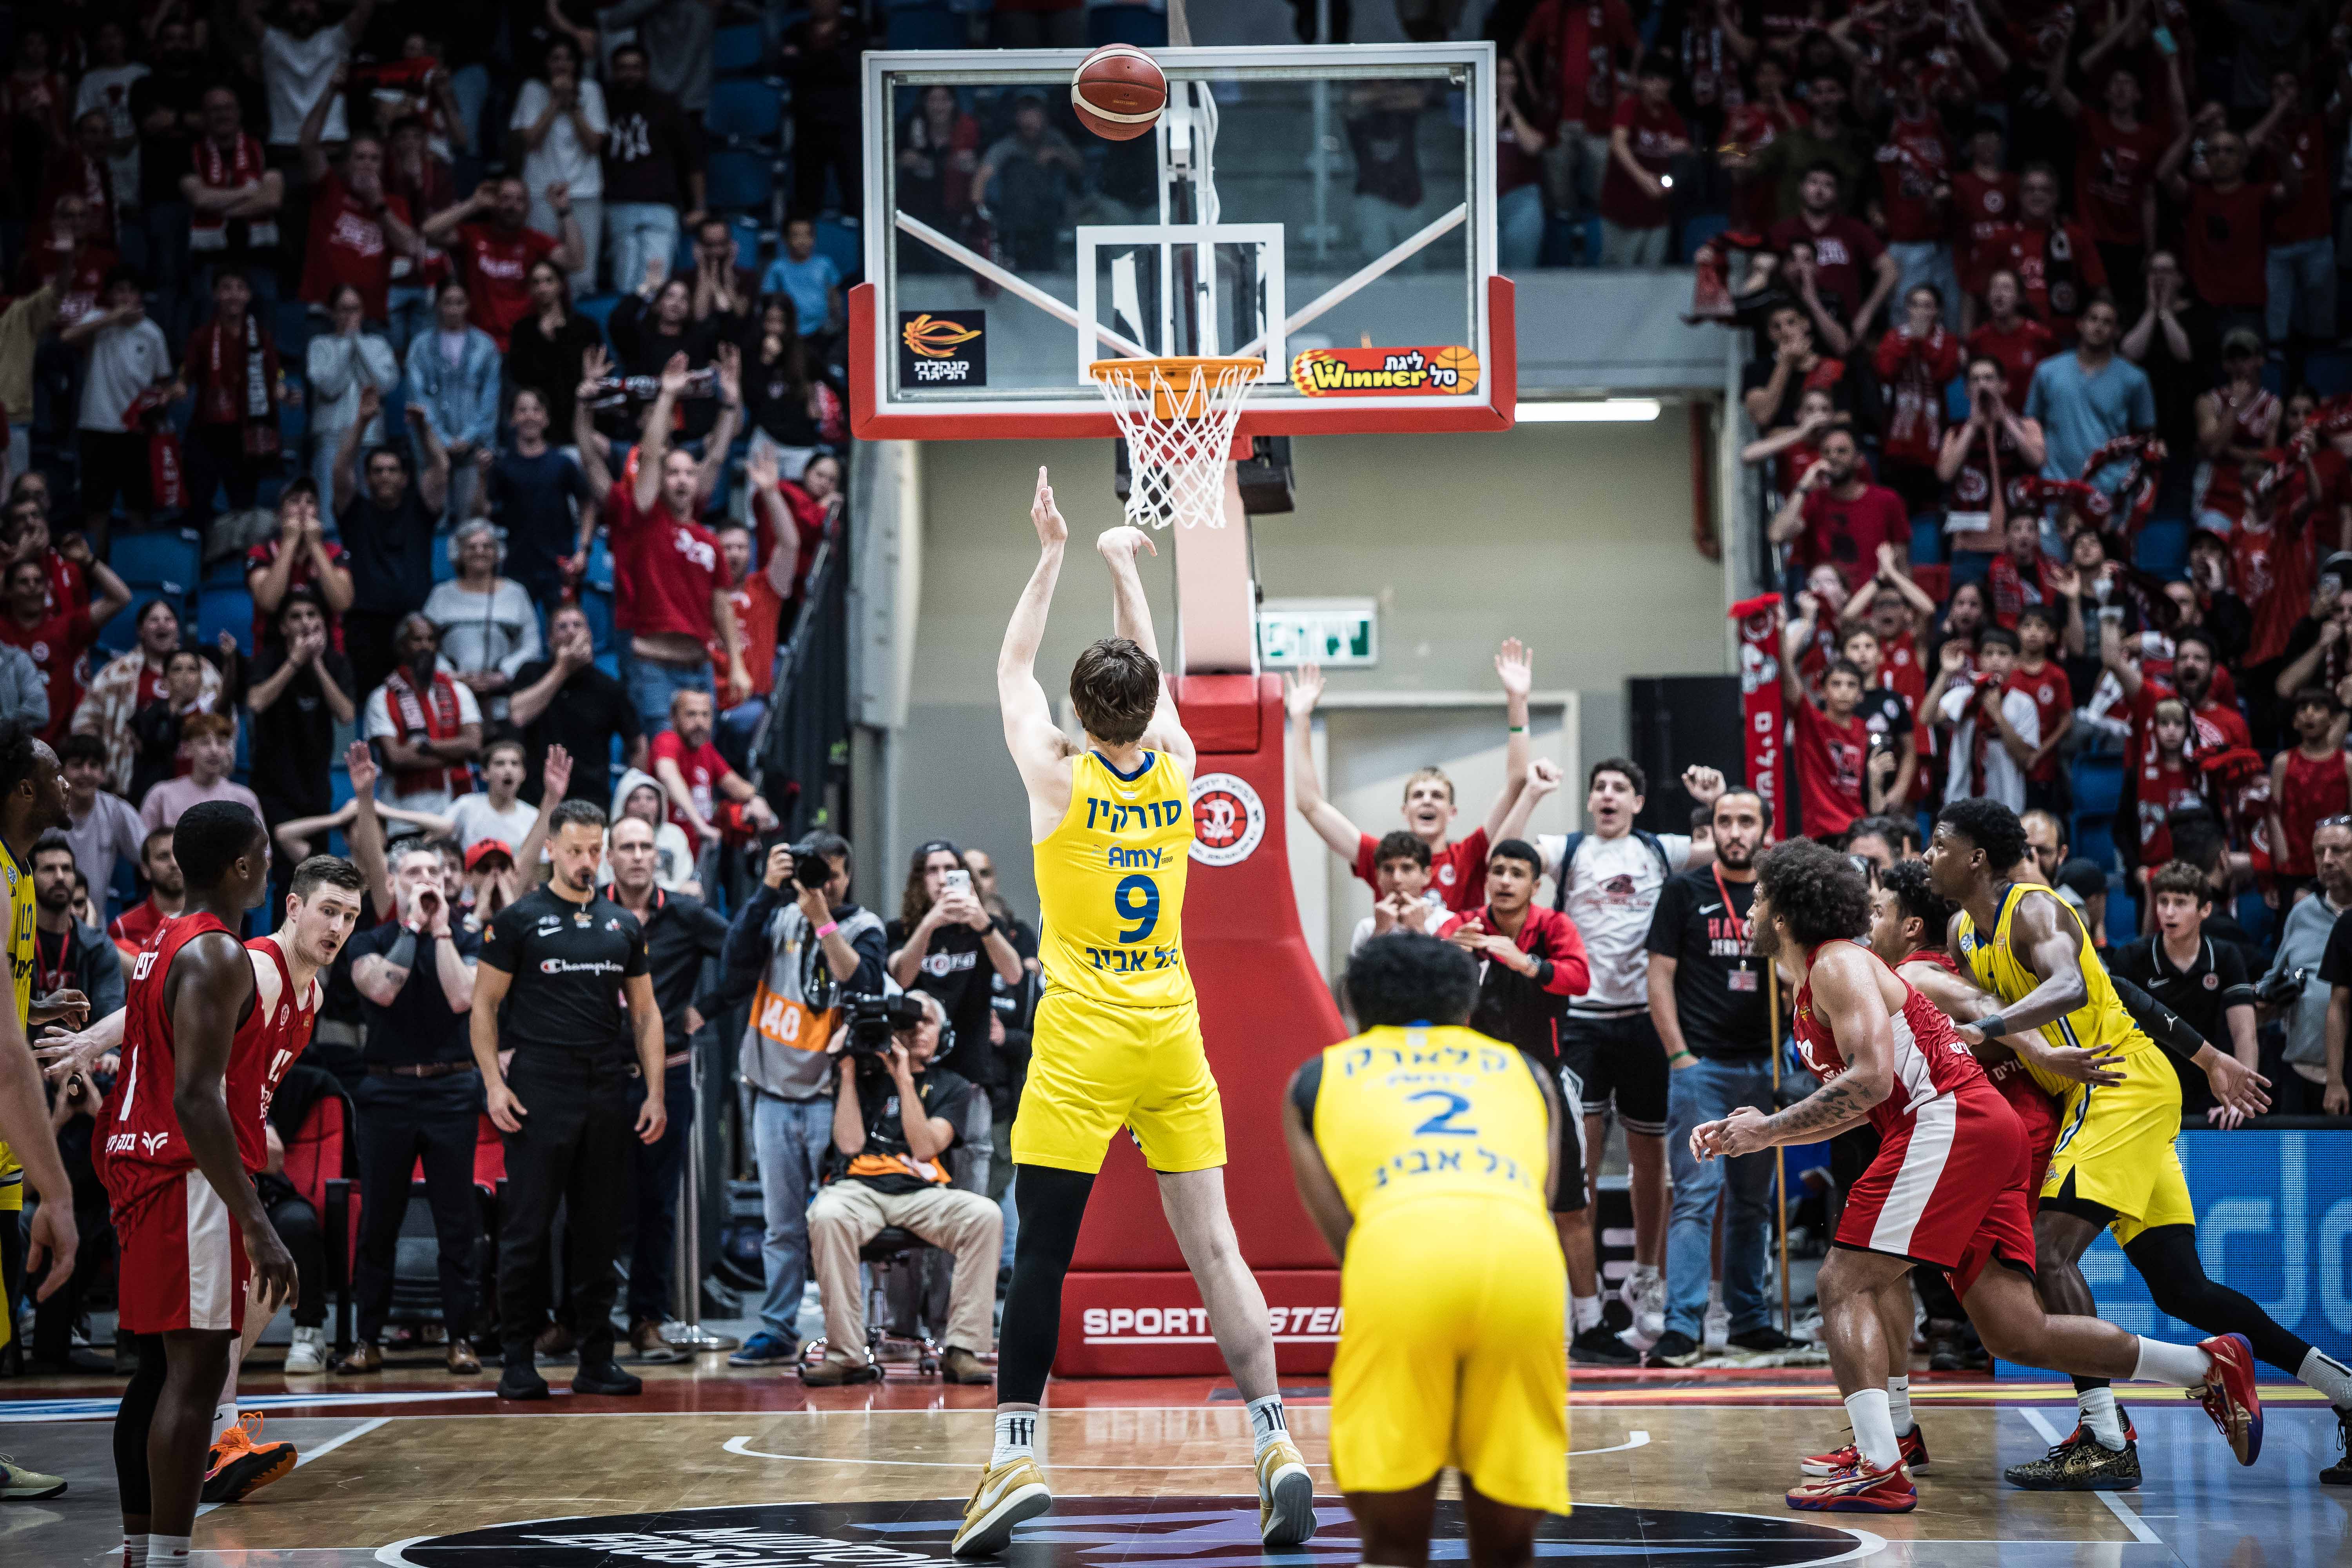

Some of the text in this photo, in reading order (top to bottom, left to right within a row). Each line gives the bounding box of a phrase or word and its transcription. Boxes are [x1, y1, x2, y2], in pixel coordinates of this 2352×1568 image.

[914, 359, 970, 372] מנהלת
[1384, 351, 1424, 371] ליגת
[917, 370, 966, 381] הליגה
[1311, 361, 1428, 389] Winner
[1429, 365, 1458, 386] סל
[1087, 797, 1182, 833] סורקין
[1108, 847, 1173, 869] Amy GROUP
[1114, 874, 1160, 944] 9
[540, 958, 624, 976] Champion
[1085, 947, 1148, 972] אביב
[1404, 1090, 1479, 1135] 2
